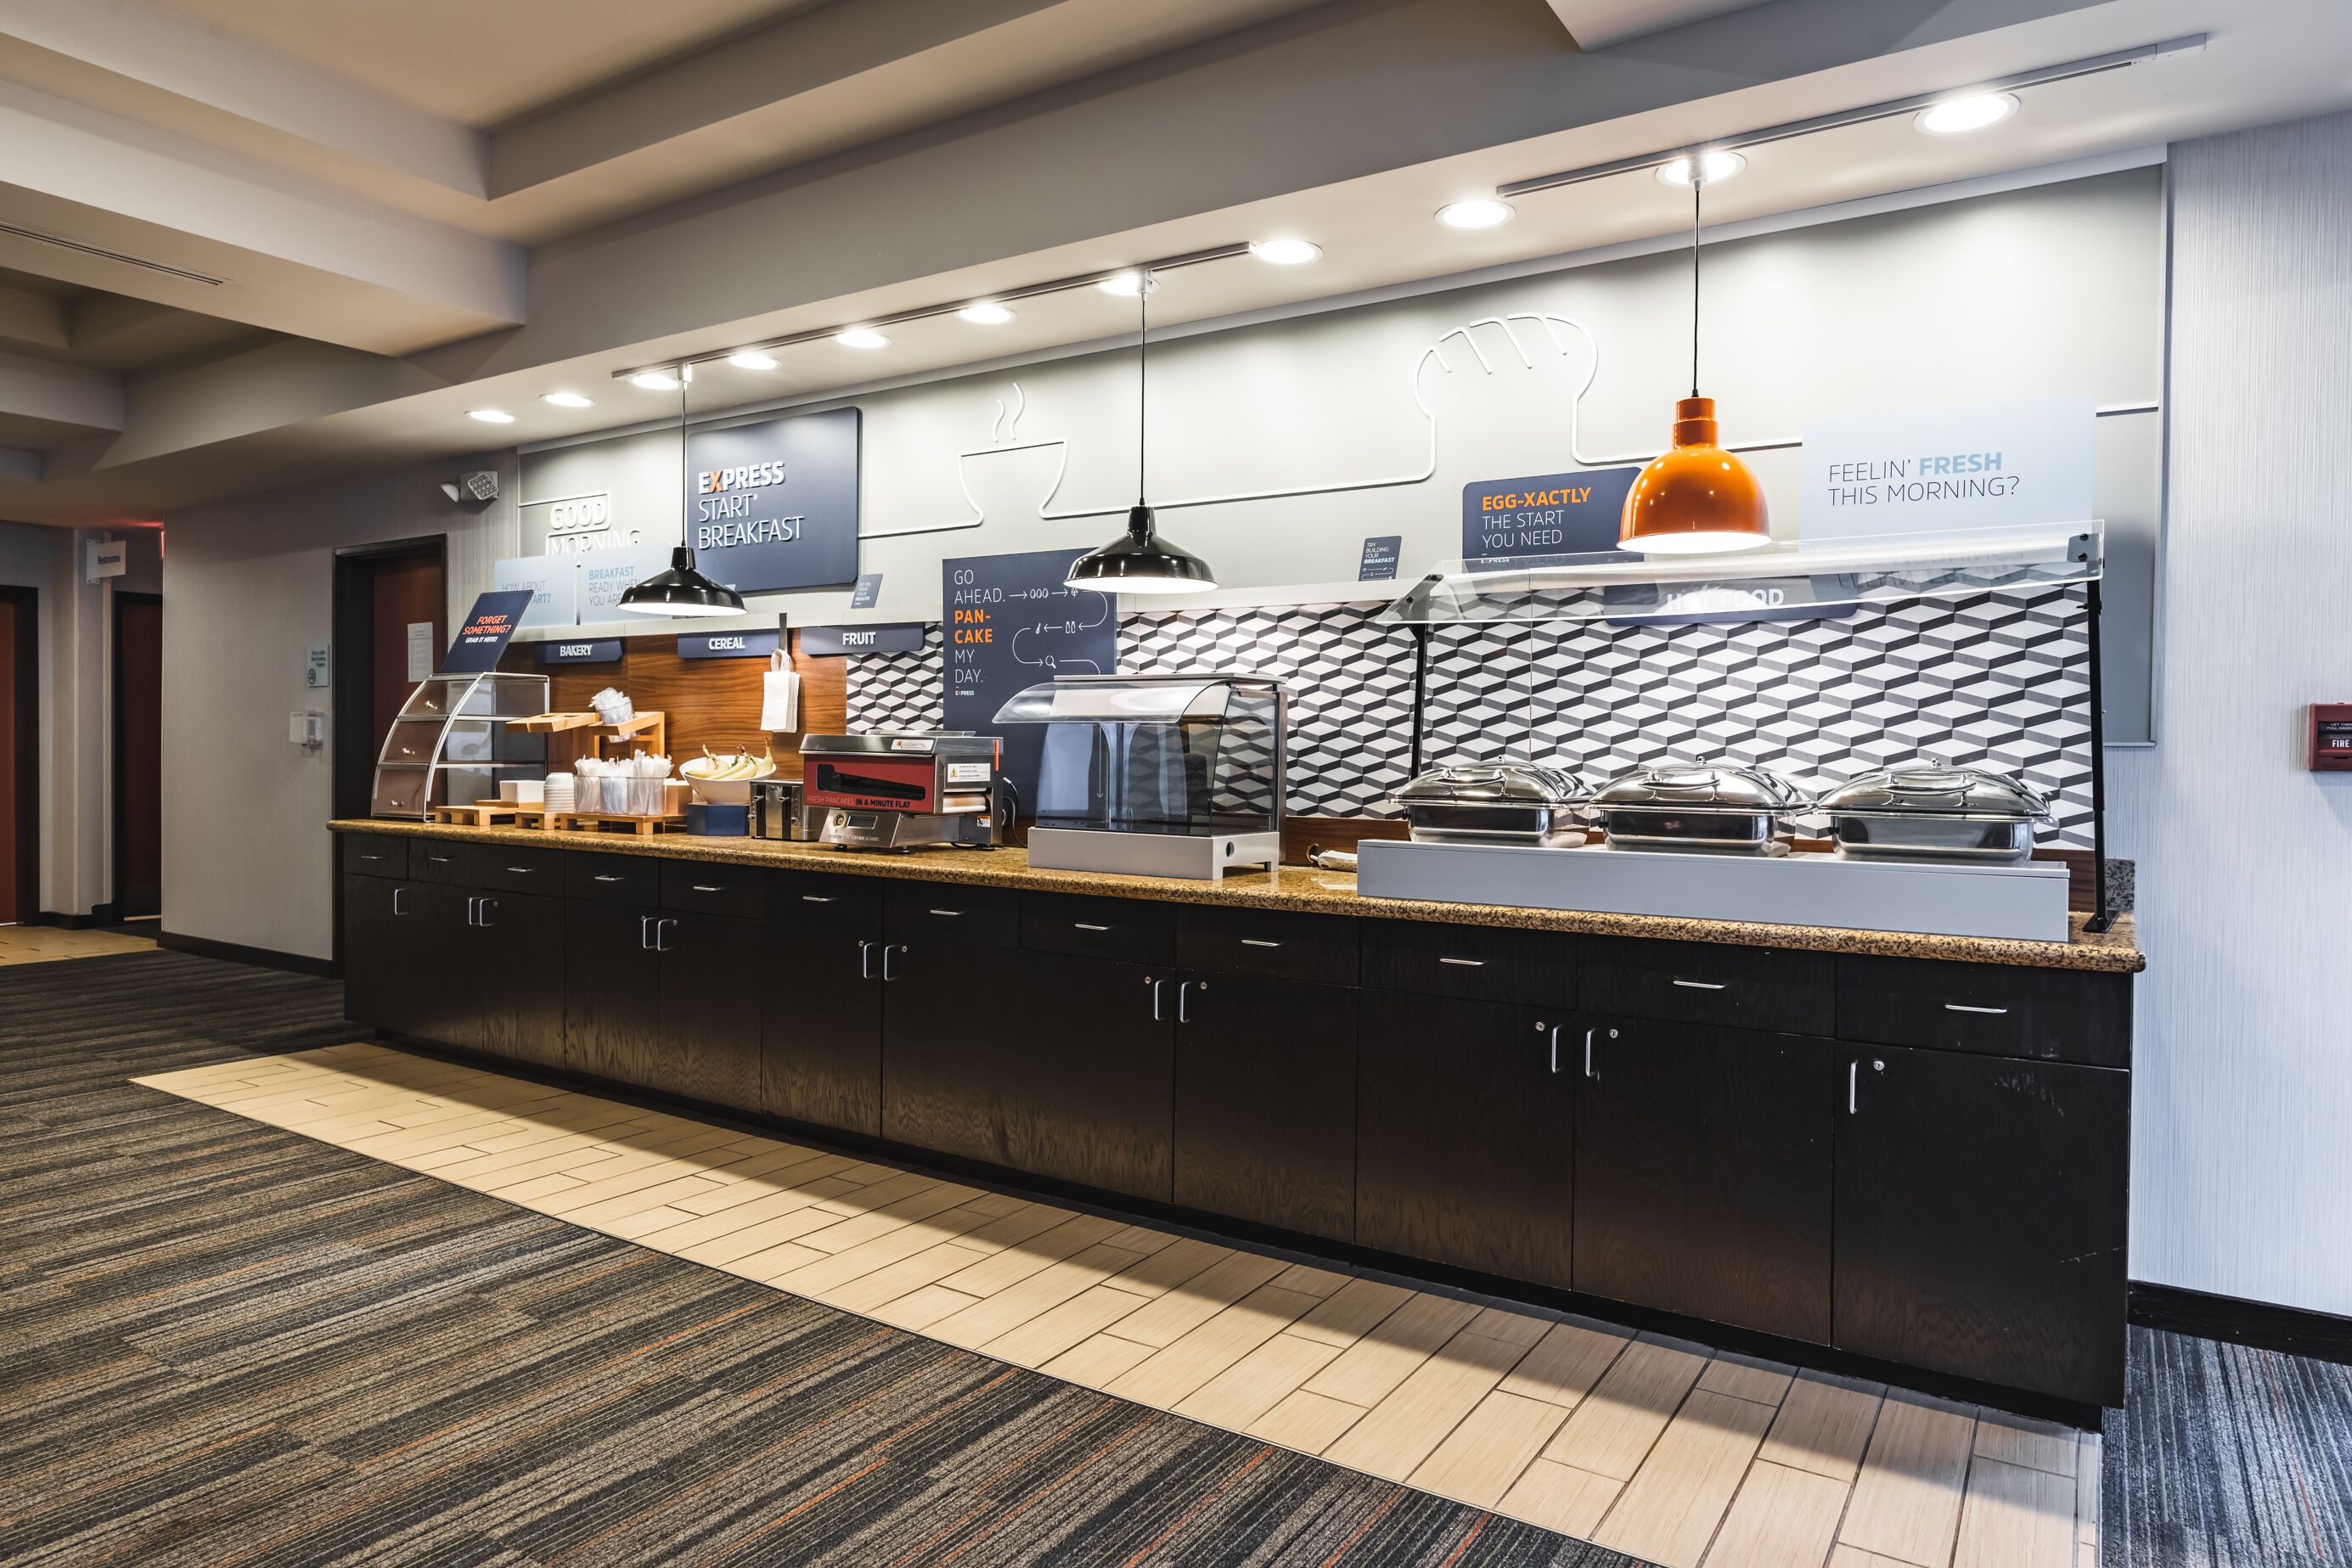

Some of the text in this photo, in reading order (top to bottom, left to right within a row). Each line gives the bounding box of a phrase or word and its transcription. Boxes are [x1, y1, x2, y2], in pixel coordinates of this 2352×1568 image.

[1919, 452, 2002, 475] FRESH
[699, 461, 785, 494] EXPRESS
[1828, 476, 2019, 506] THIS MORNING?
[1483, 487, 1591, 511] EGG-XACTLY
[550, 499, 607, 531] GOOD
[1482, 510, 1564, 530] THE START
[698, 516, 805, 549] BREAKFAST
[1482, 530, 1562, 548] YOU NEED
[588, 566, 635, 581] BREAKFAST
[954, 570, 974, 585] GO
[588, 580, 613, 593] READY
[530, 593, 551, 604] ART?
[588, 595, 605, 606] YOU
[954, 588, 1005, 604] AHEAD.
[476, 615, 508, 625] FORGET
[954, 610, 991, 624] PAN-
[462, 625, 511, 635] SOMETHING?
[954, 628, 993, 644] CAKE
[708, 637, 746, 650] CEREAL
[842, 632, 876, 645] FRUIT
[560, 644, 593, 657] BAKERY
[955, 649, 975, 664] MY
[955, 669, 983, 683] DAY.
[2332, 739, 2350, 748] FIRE
[807, 795, 824, 804] FRESH
[825, 796, 854, 806] PANCAKES
[869, 799, 894, 808] MINUTE
[895, 801, 911, 809] FLAT
